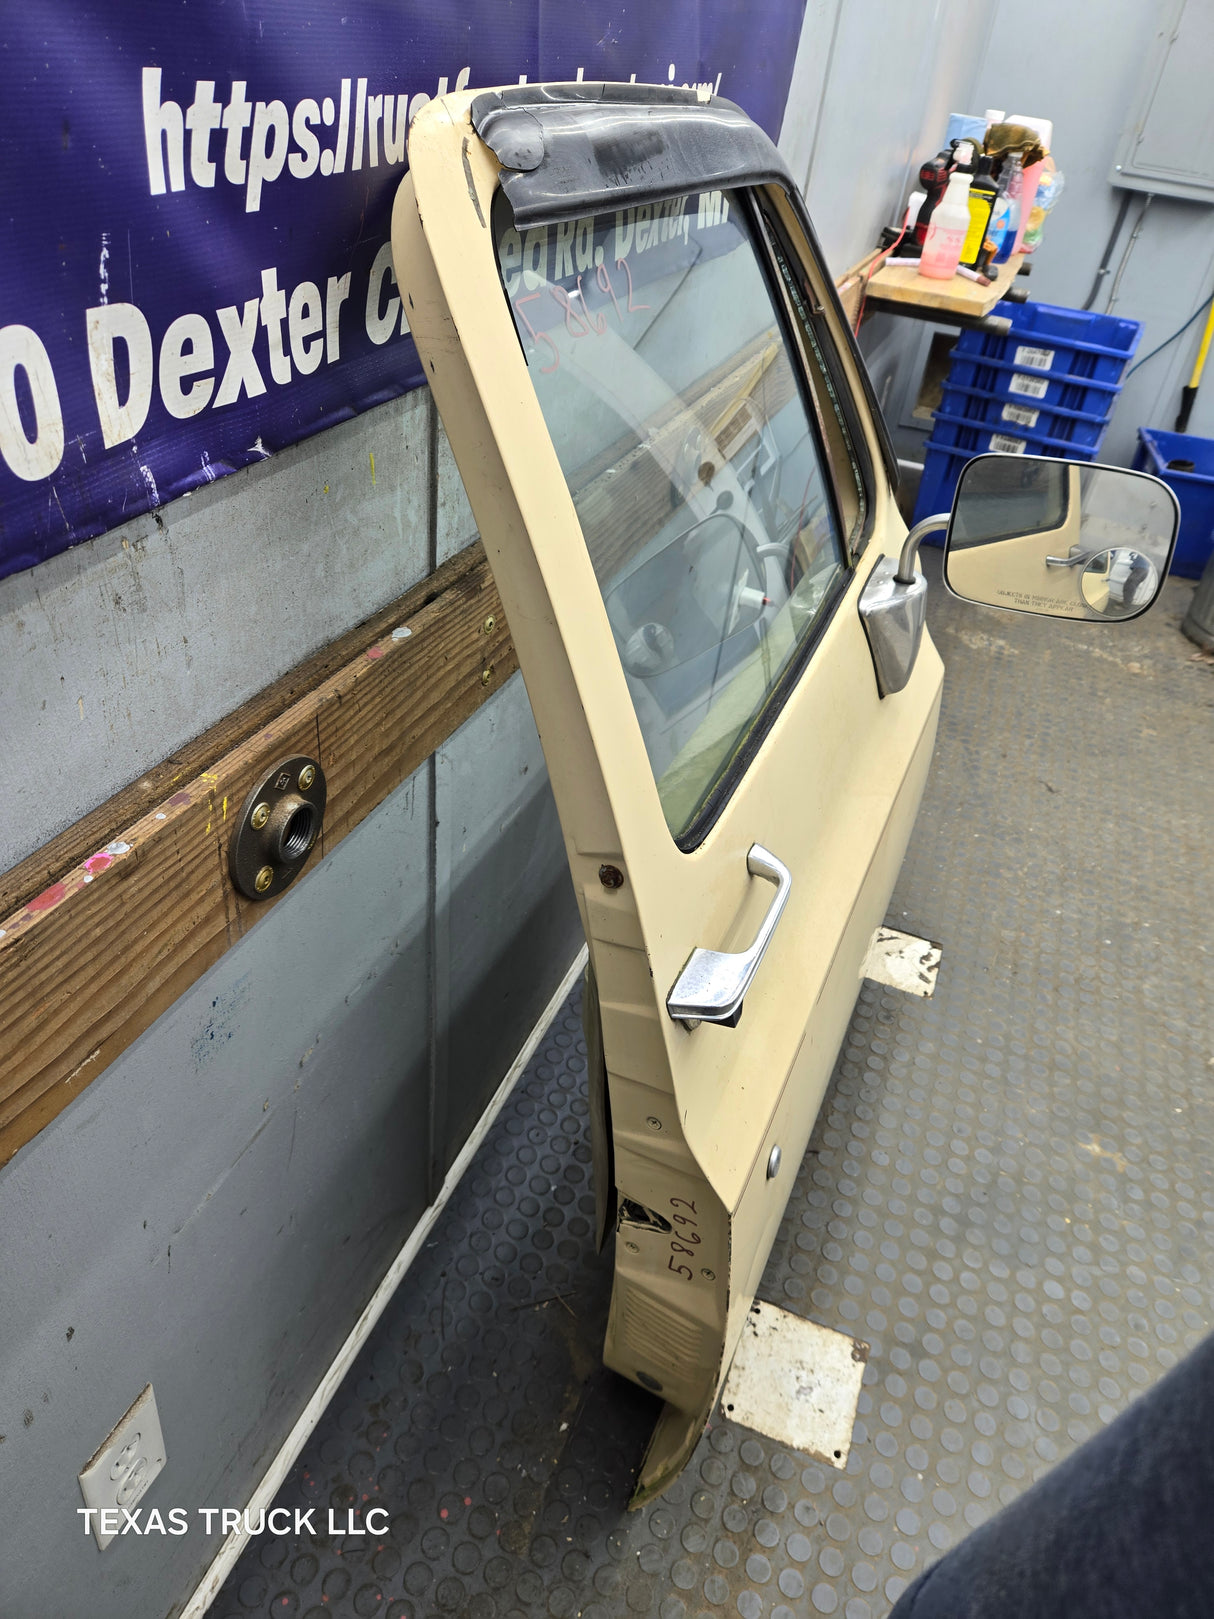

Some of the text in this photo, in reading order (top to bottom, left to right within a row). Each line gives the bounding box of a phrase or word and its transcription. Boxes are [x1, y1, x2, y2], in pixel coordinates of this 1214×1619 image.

[86, 267, 352, 450] Dexter
[365, 240, 411, 346] C
[514, 257, 651, 374] 58692
[668, 1197, 702, 1281] 58692
